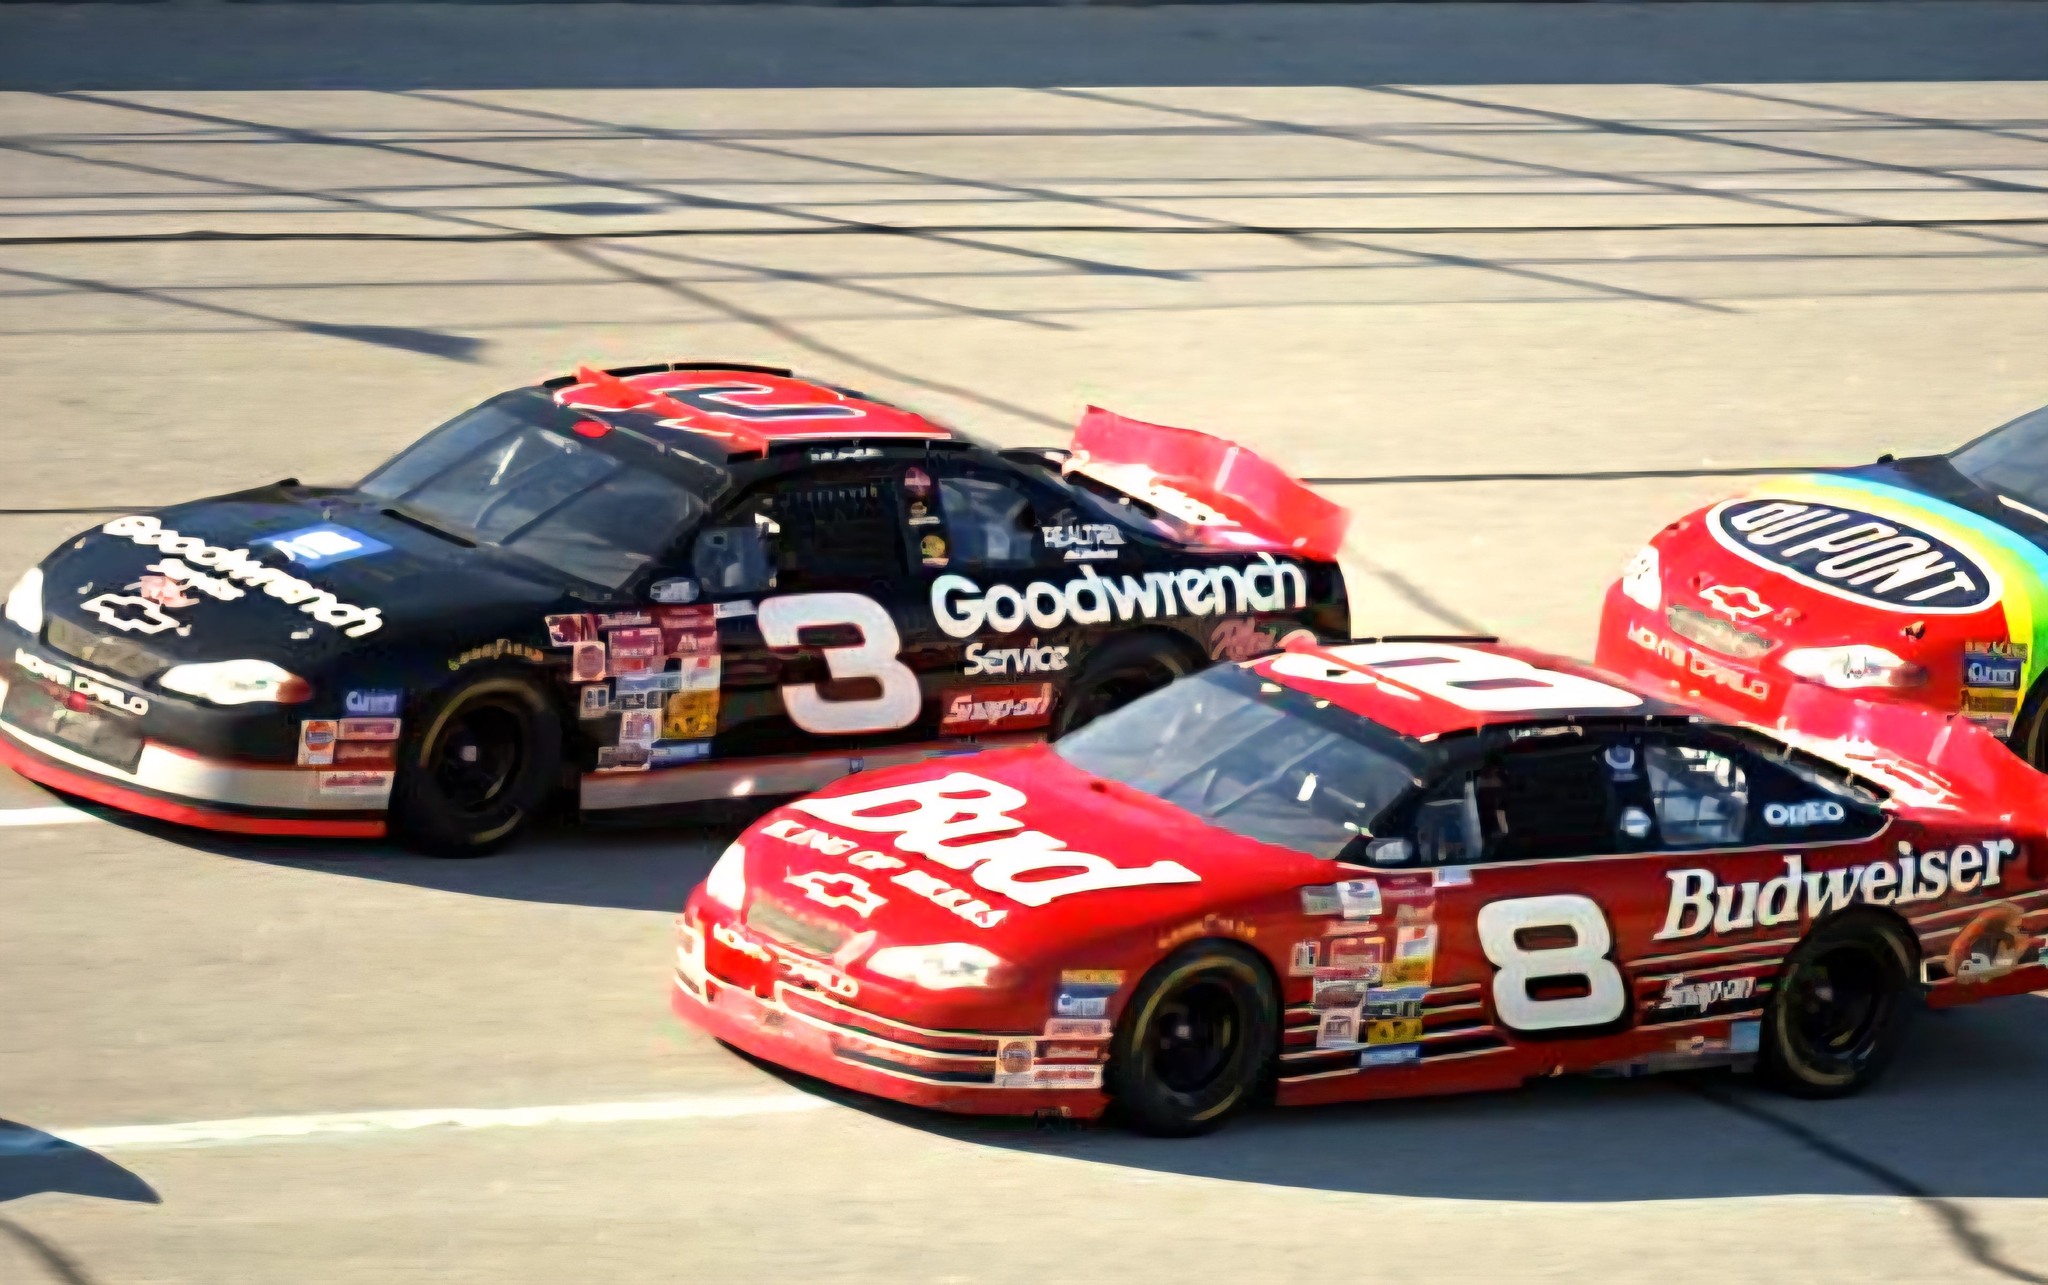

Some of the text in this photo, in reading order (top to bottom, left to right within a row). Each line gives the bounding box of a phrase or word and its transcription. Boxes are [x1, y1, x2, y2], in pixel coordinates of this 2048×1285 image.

[931, 551, 1307, 638] Goodwrench
[1731, 502, 1977, 602] DU PONT
[757, 592, 922, 734] 3
[964, 637, 1070, 676] Service
[788, 771, 1202, 908] Bud
[1652, 838, 2016, 941] Budweiser
[1476, 894, 1625, 1031] 8
